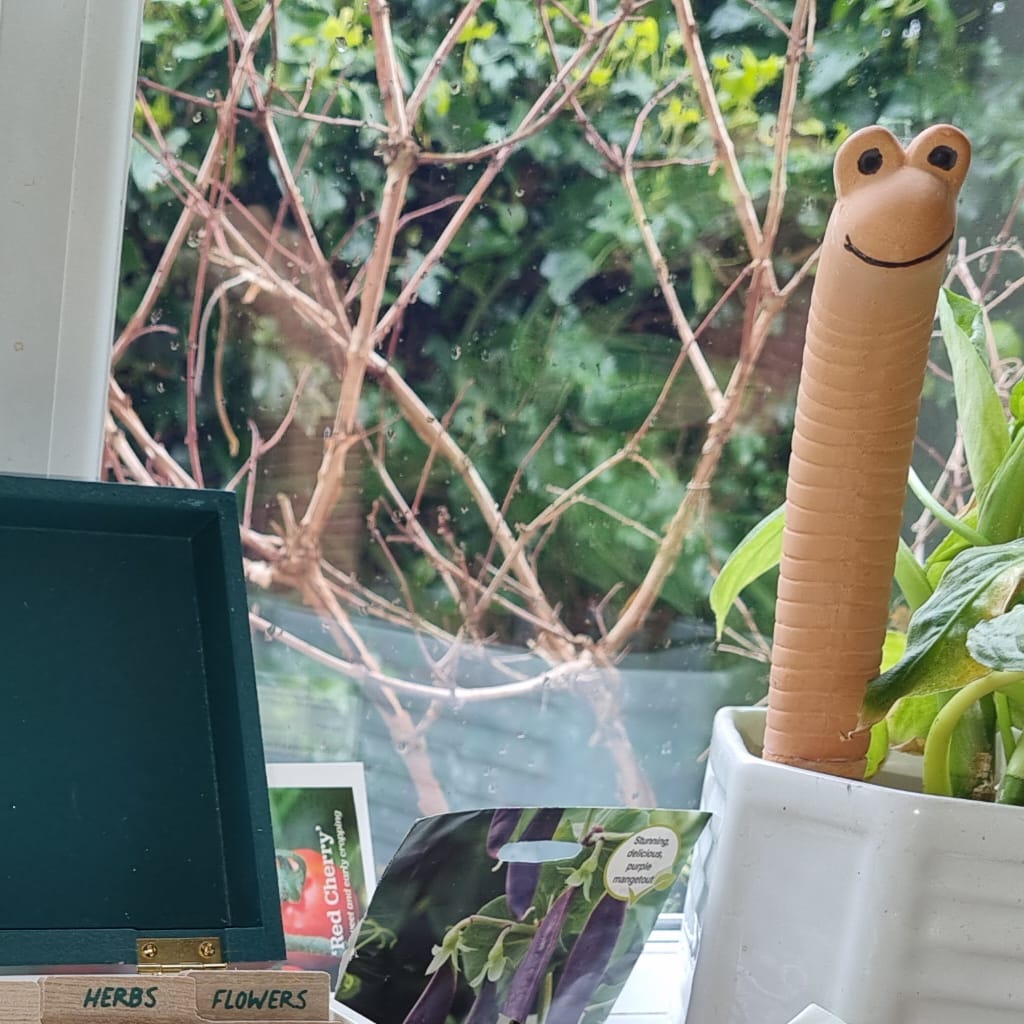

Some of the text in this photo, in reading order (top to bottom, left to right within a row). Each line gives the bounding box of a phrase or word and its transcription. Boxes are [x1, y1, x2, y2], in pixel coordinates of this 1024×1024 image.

[334, 810, 349, 857] cropping
[634, 836, 669, 847] Stunning,
[627, 849, 663, 858] delicious,
[340, 859, 352, 887] early
[625, 863, 652, 872] purple
[612, 876, 654, 886] mangetout
[344, 888, 354, 910] and
[82, 985, 158, 1010] HERBS
[212, 988, 309, 1010] FLOWERS
